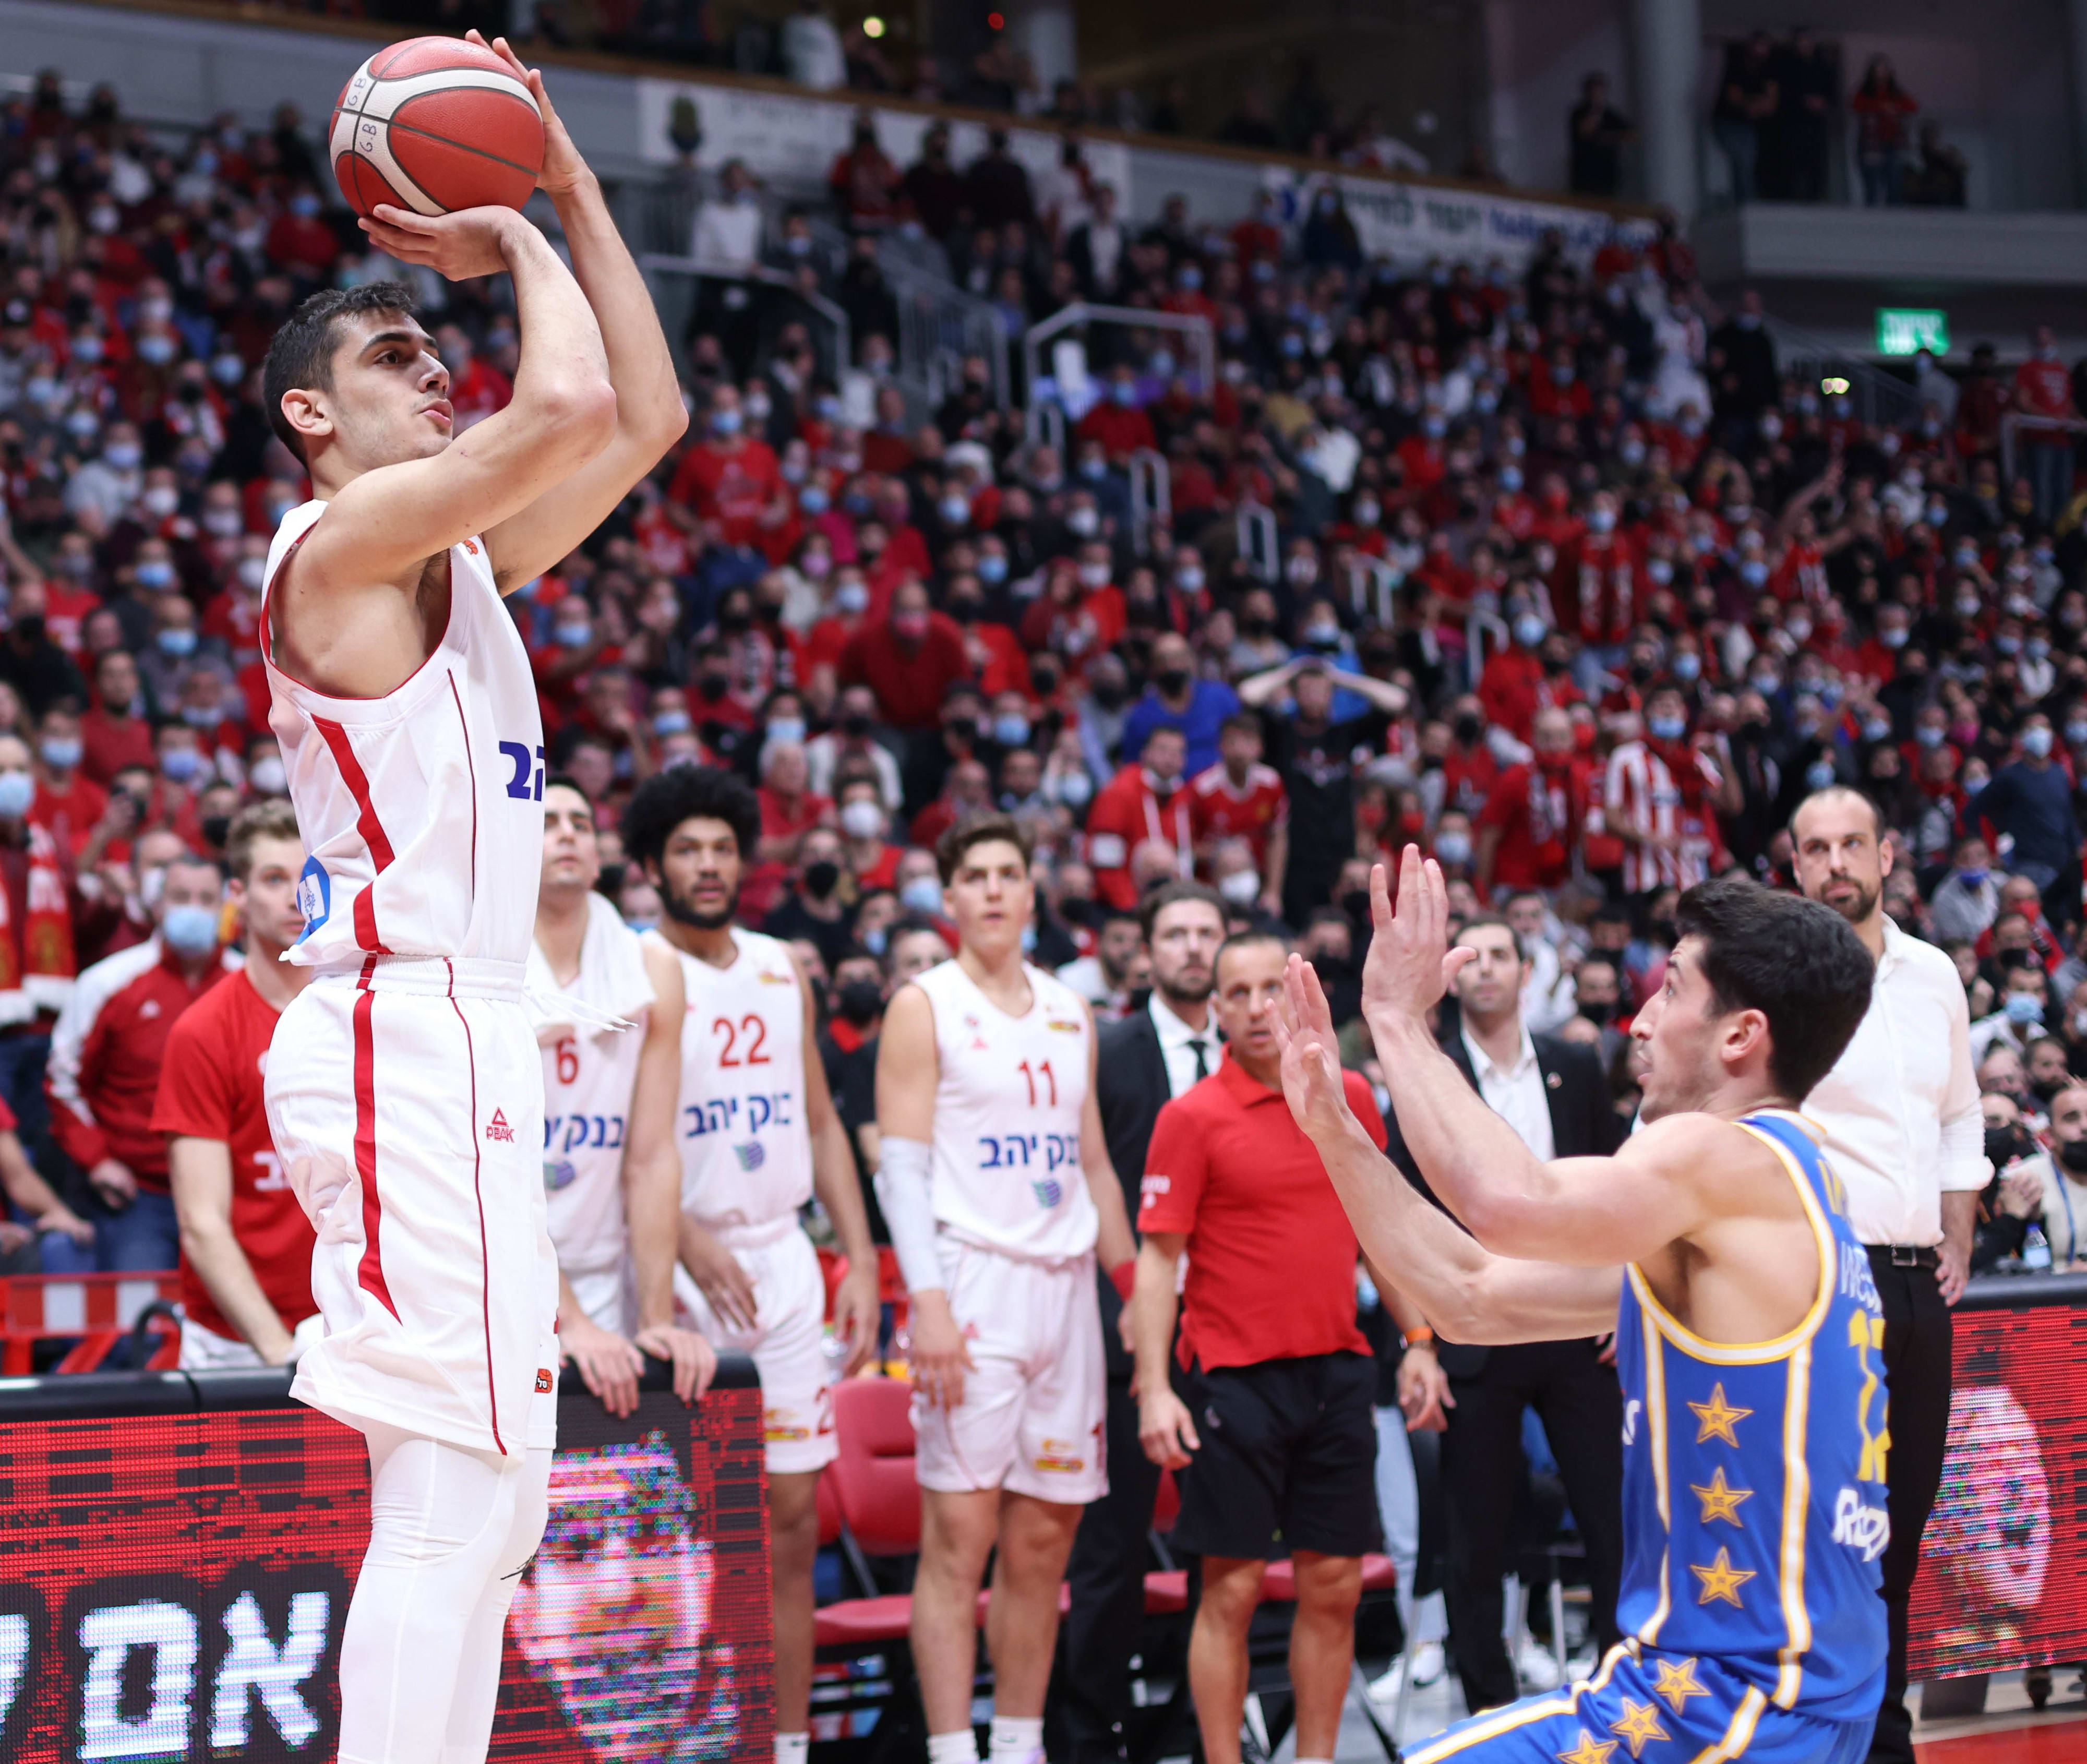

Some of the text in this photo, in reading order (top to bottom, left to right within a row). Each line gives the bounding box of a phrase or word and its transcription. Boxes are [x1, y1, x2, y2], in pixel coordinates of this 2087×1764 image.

[359, 123, 377, 153] G.B
[556, 1035, 579, 1085] 6
[713, 1014, 770, 1067] 22
[1018, 1058, 1057, 1107] 11
[486, 1125, 515, 1143] PEAK
[685, 1098, 738, 1138] יהב
[979, 1135, 1037, 1169] יהב
